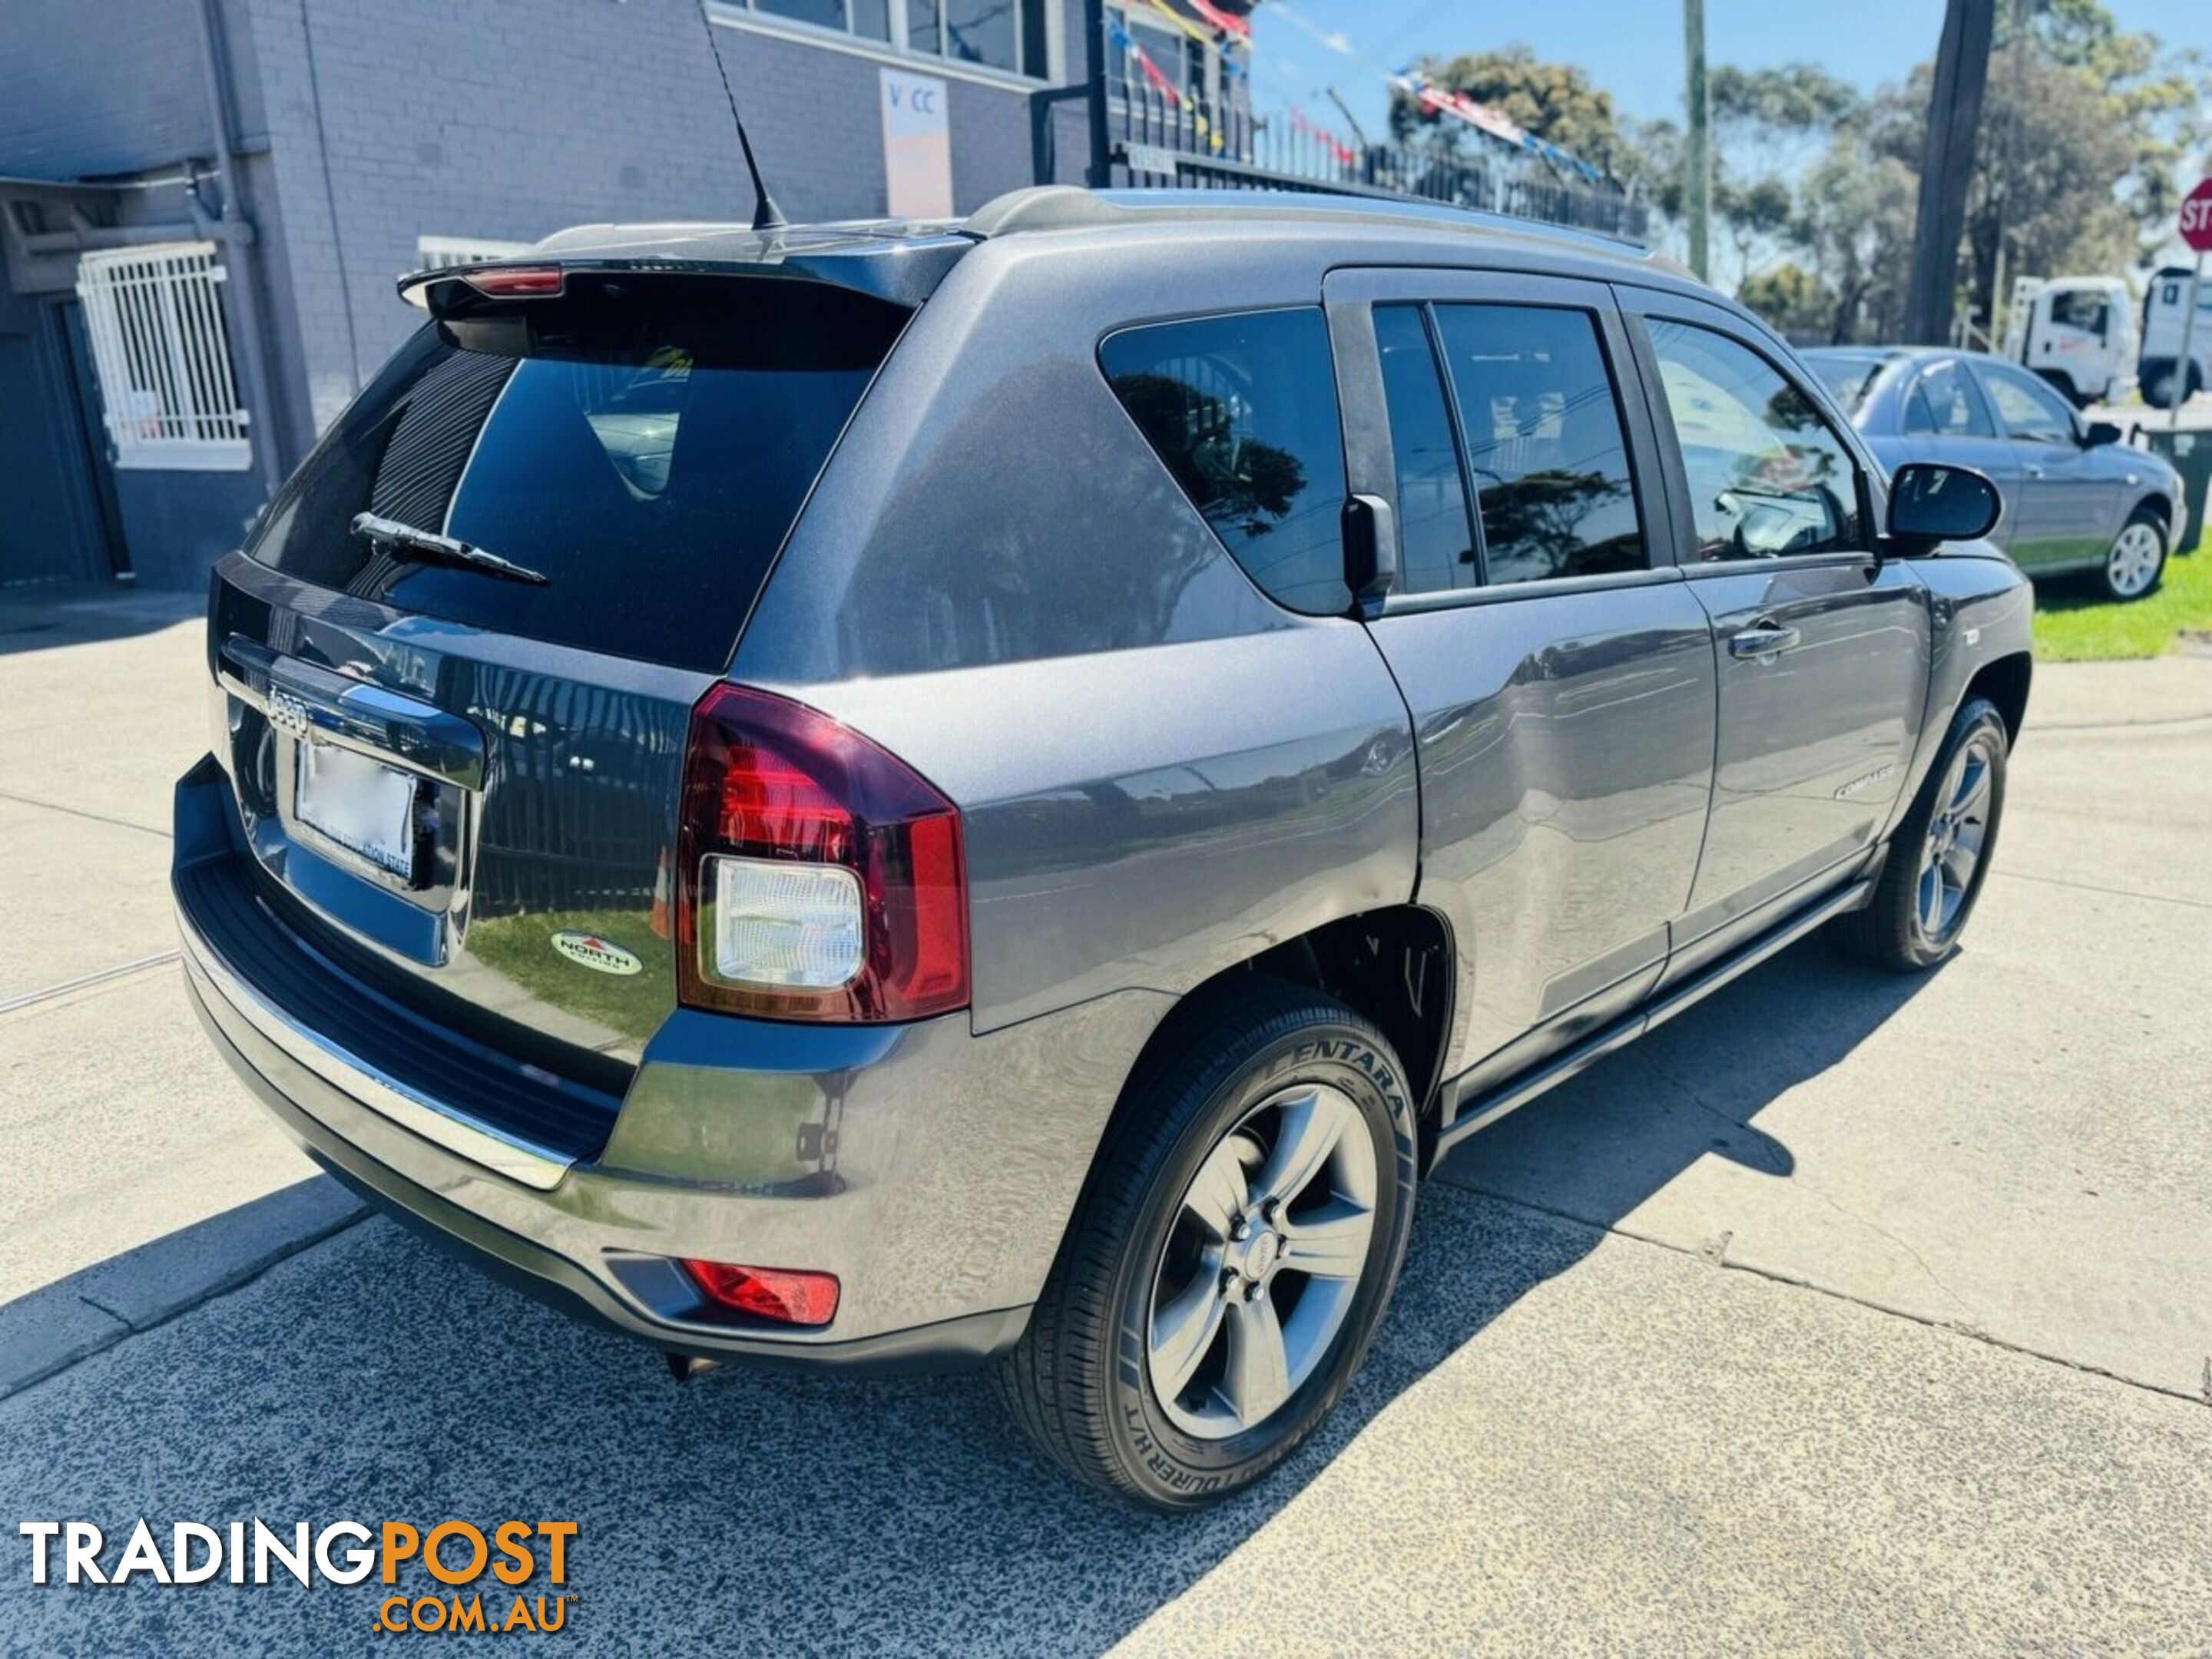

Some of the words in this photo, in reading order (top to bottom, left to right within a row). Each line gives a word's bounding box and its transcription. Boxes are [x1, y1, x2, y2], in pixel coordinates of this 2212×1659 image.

[2181, 198, 2212, 232] ST
[266, 684, 307, 735] Jeep
[387, 852, 410, 878] STATE
[561, 940, 630, 967] NORTH
